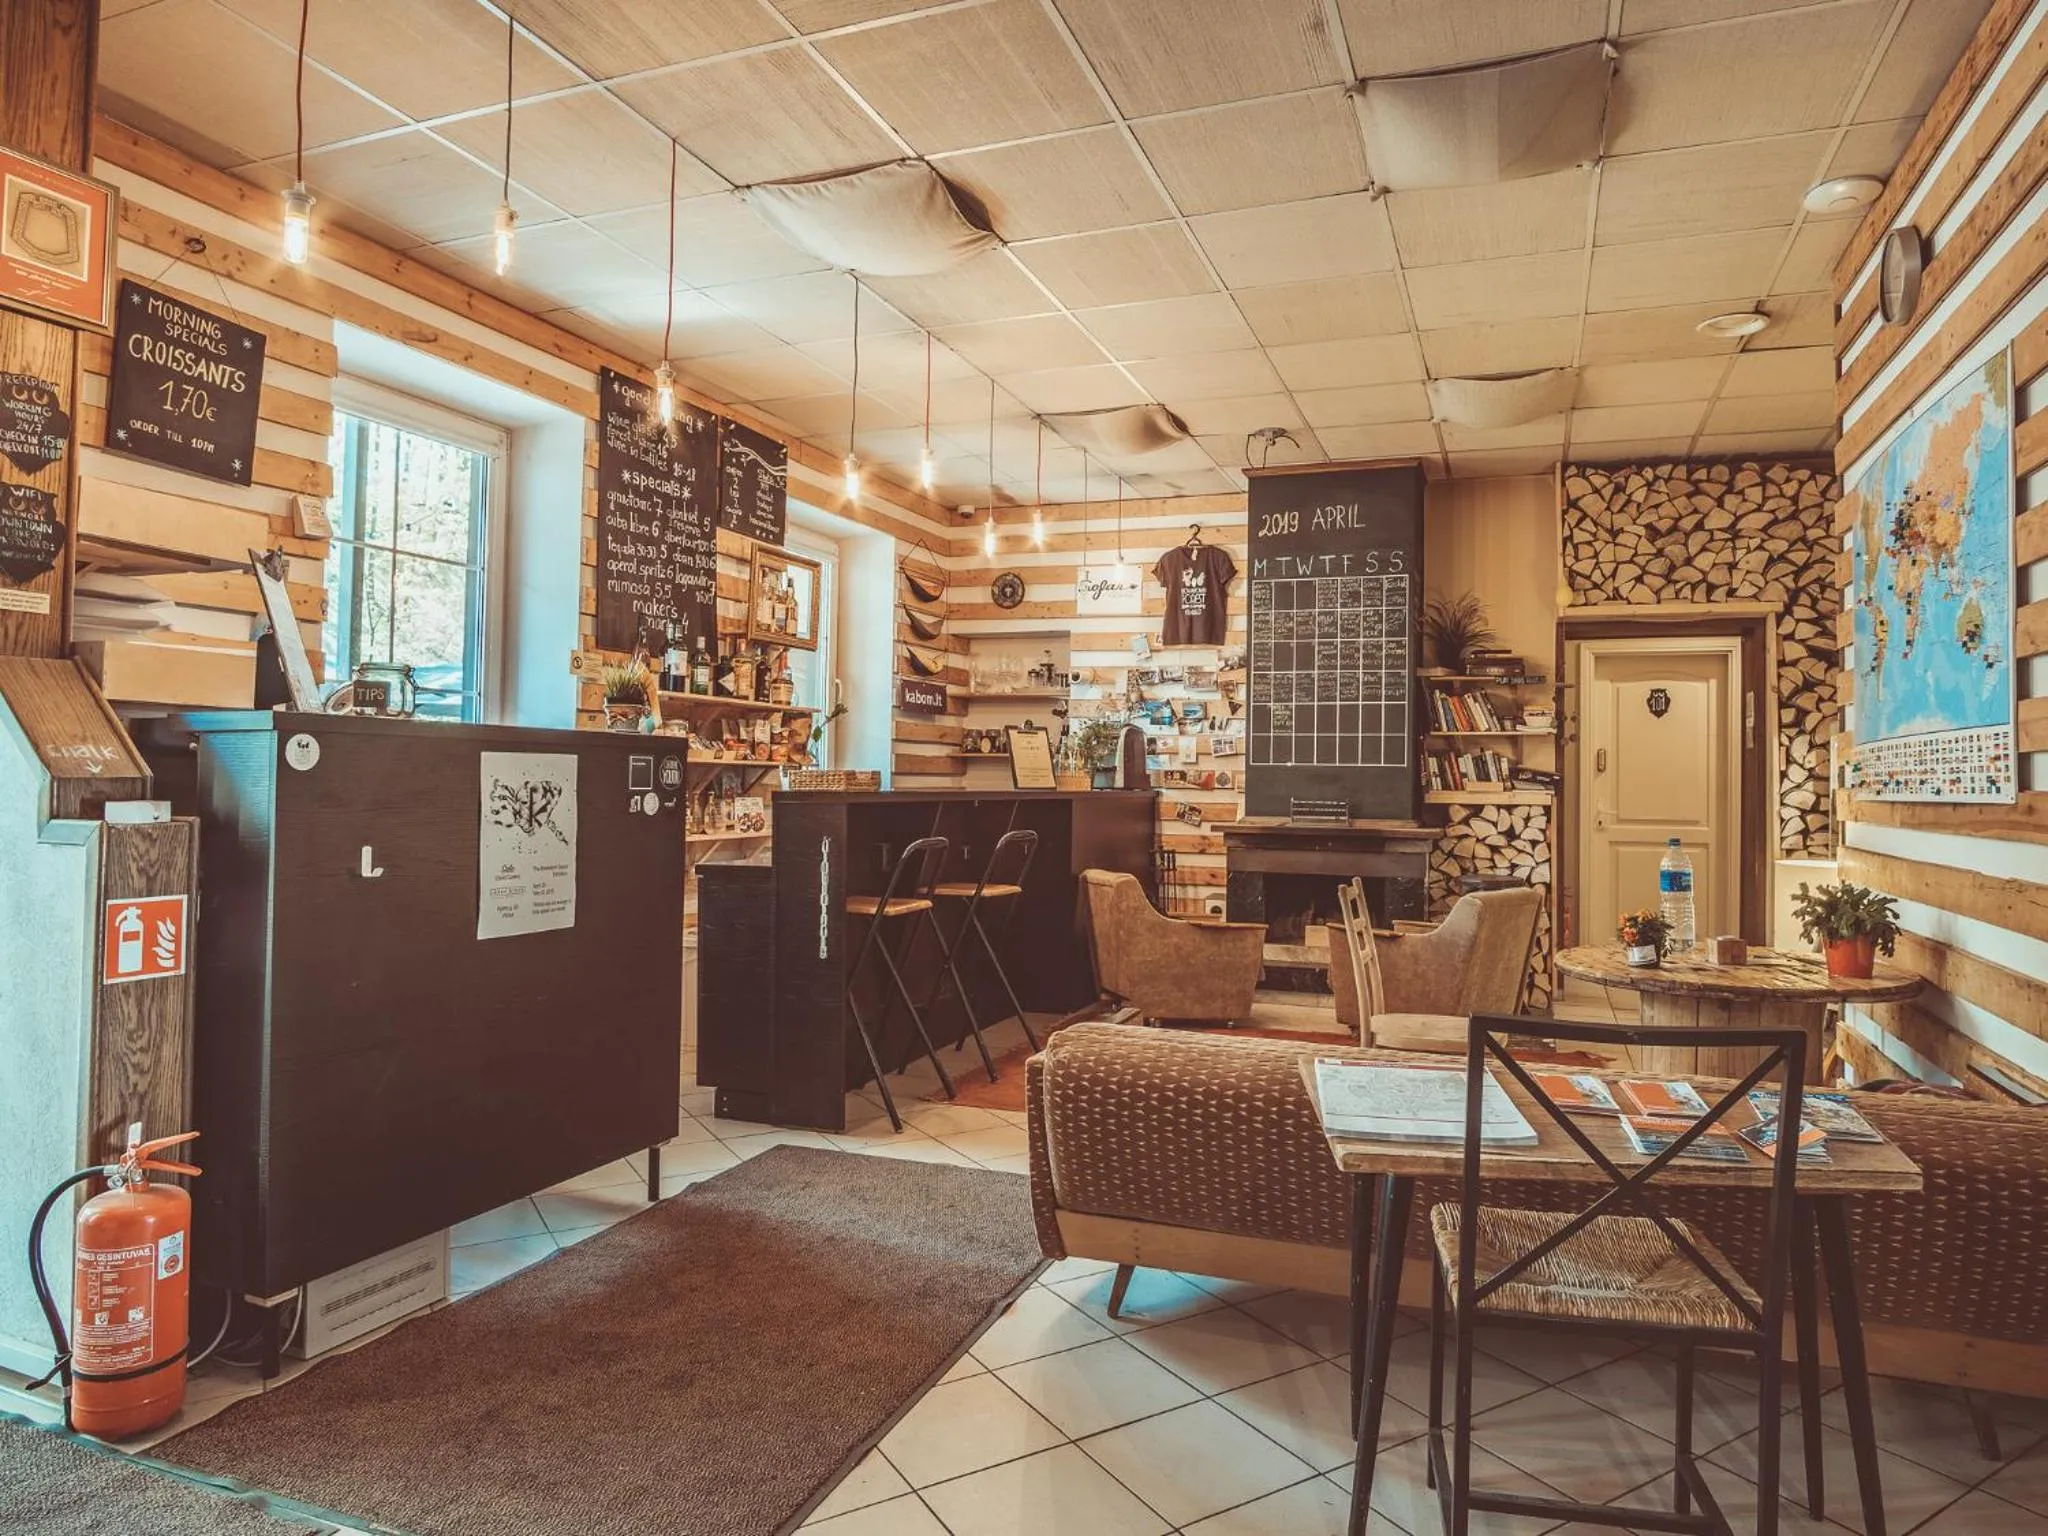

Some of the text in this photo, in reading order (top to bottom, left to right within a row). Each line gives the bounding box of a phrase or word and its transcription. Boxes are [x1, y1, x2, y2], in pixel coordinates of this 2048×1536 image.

[148, 297, 221, 339] MORNING
[165, 323, 228, 356] SPECIALS
[128, 334, 246, 393] CROISSANTS
[2, 398, 53, 418] WORKING
[15, 410, 45, 424] HOURS
[16, 420, 42, 434] 24/7
[130, 419, 160, 436] ORDER
[166, 430, 183, 443] TILL
[10, 486, 42, 501] WIFI
[1258, 504, 1366, 537] 2019 APRIL
[652, 521, 660, 538] 6
[660, 544, 667, 559] 5
[667, 565, 674, 579] 6
[1254, 551, 1403, 577] M T W T F S S
[607, 580, 650, 596] mimosa
[357, 687, 385, 701] TIPS
